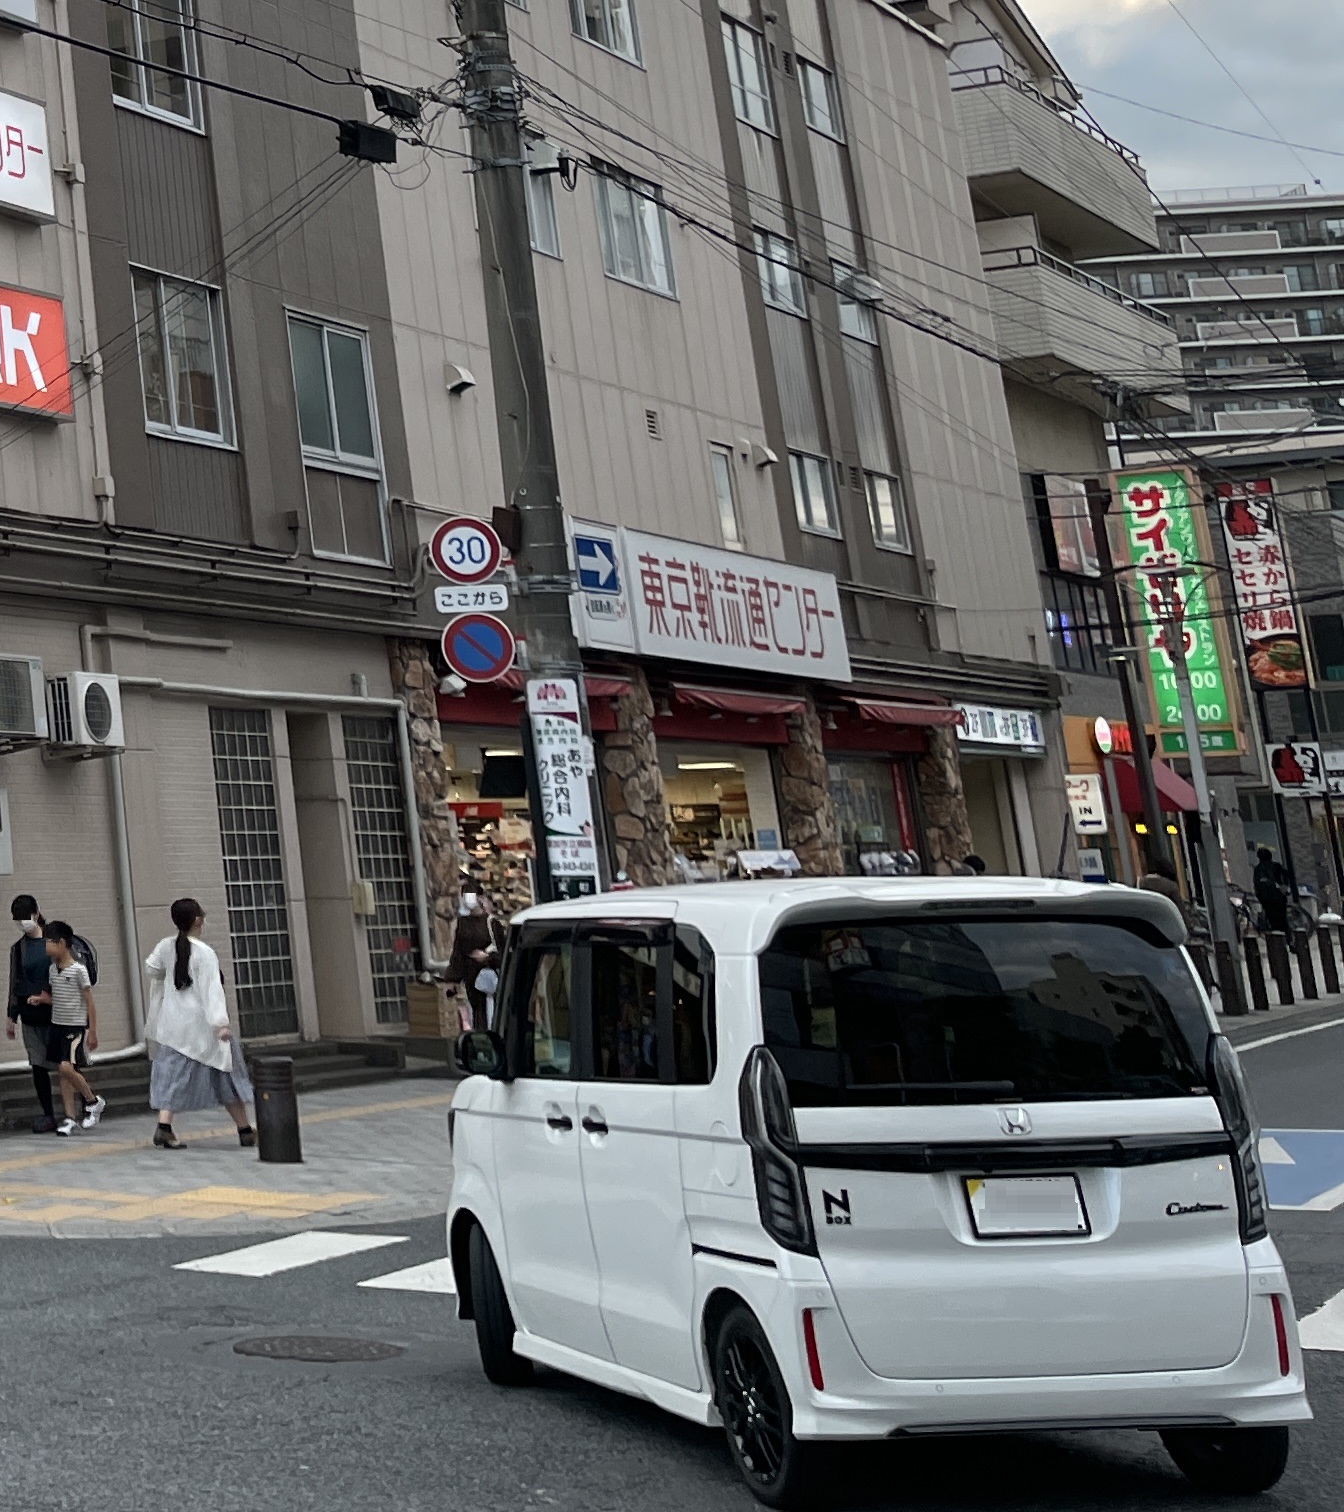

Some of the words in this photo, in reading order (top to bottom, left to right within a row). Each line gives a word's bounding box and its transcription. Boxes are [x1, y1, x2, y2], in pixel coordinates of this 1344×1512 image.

[448, 535, 487, 567] 30
[440, 590, 504, 608] ここから
[1258, 544, 1295, 632] 赤から鍋
[637, 550, 836, 659] 東京靴流通センター
[551, 753, 572, 818] 総合内科
[1079, 807, 1094, 816] IN
[822, 1189, 851, 1213] N
[825, 1215, 852, 1226] BOX
